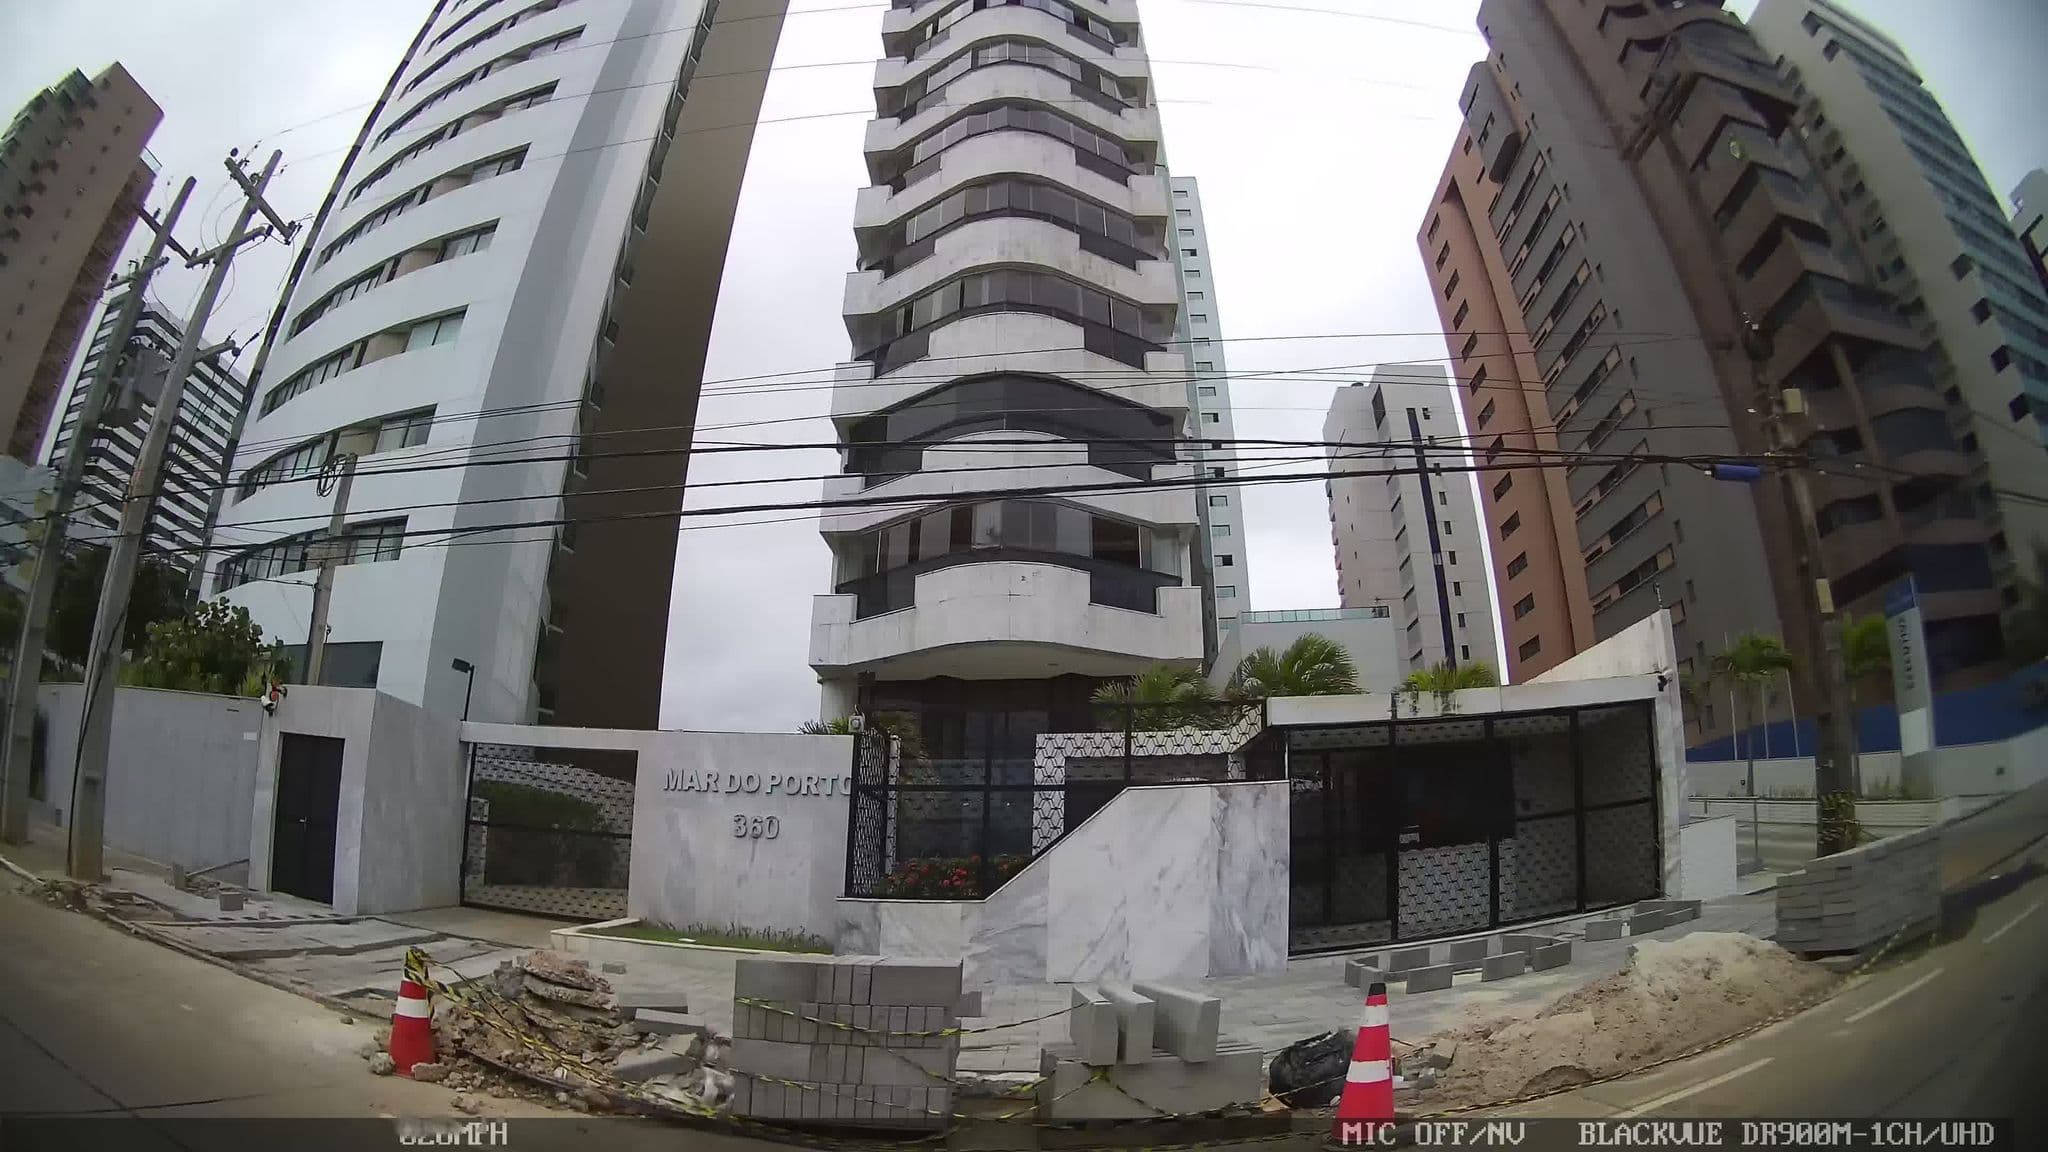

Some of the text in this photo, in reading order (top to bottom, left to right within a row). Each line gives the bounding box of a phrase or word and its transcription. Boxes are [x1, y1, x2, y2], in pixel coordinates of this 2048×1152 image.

[663, 768, 720, 793] MAR
[723, 773, 761, 794] DO
[733, 814, 780, 839] 360
